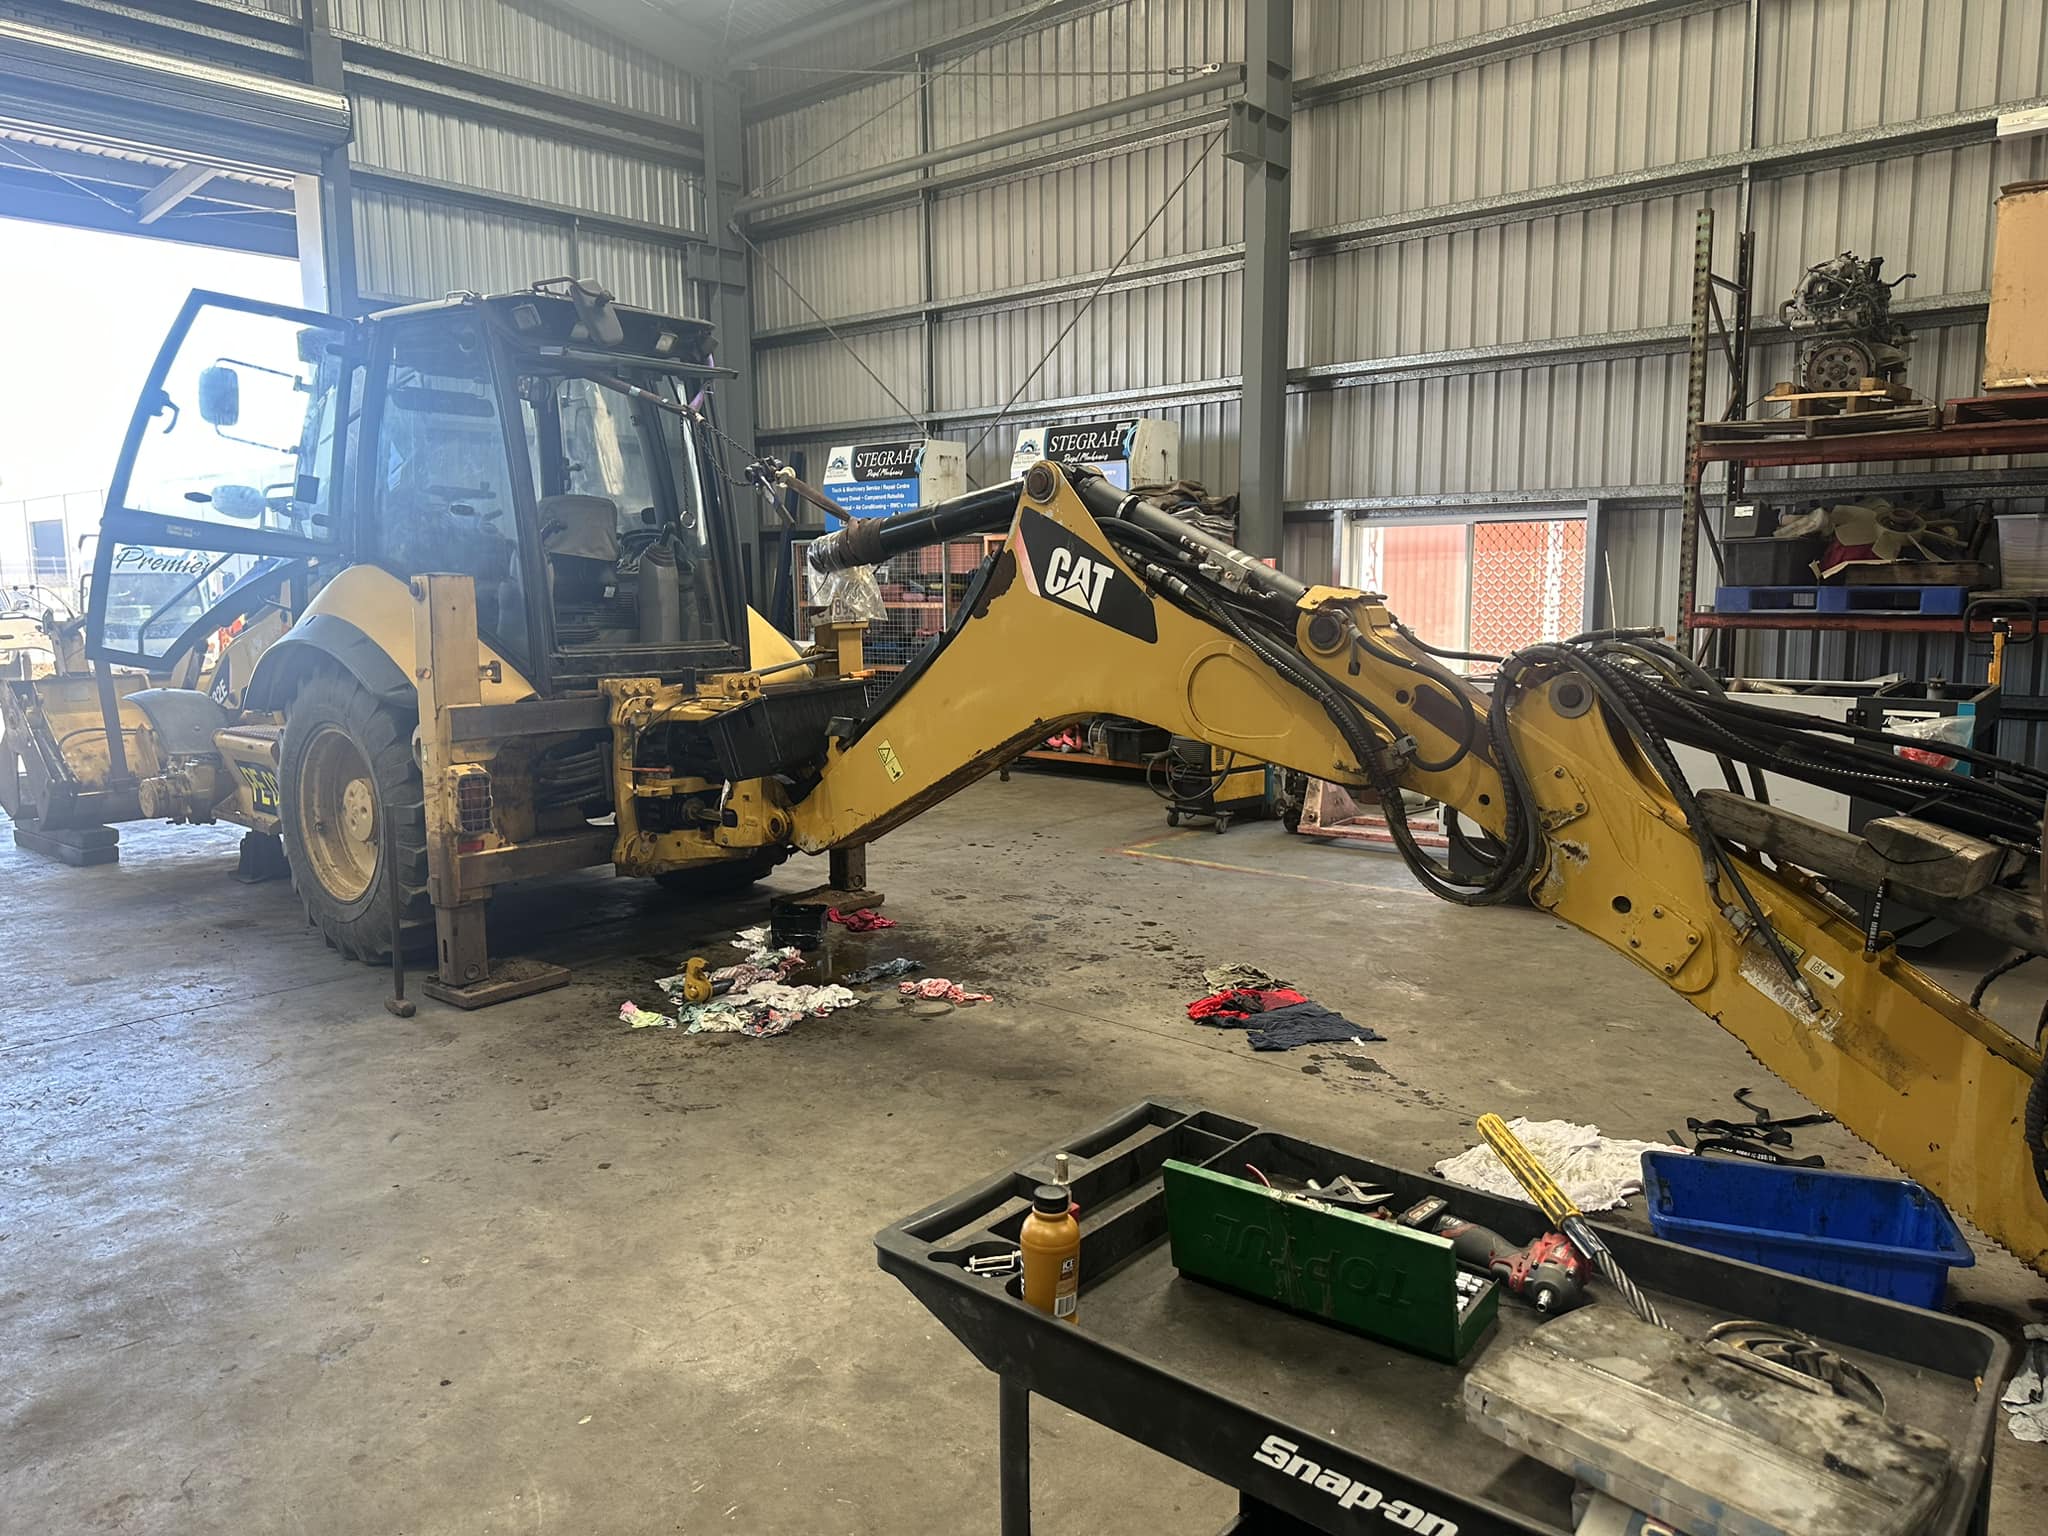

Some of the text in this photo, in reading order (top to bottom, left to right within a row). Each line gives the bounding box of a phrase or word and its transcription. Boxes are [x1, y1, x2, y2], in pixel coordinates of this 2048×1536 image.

[1049, 431, 1121, 453] STEGRAH
[855, 449, 914, 468] STEGRAH
[861, 502, 886, 510] Conditioning
[864, 494, 886, 502] Component
[1044, 547, 1115, 614] CAT
[1252, 1434, 1459, 1536] Snap-on
